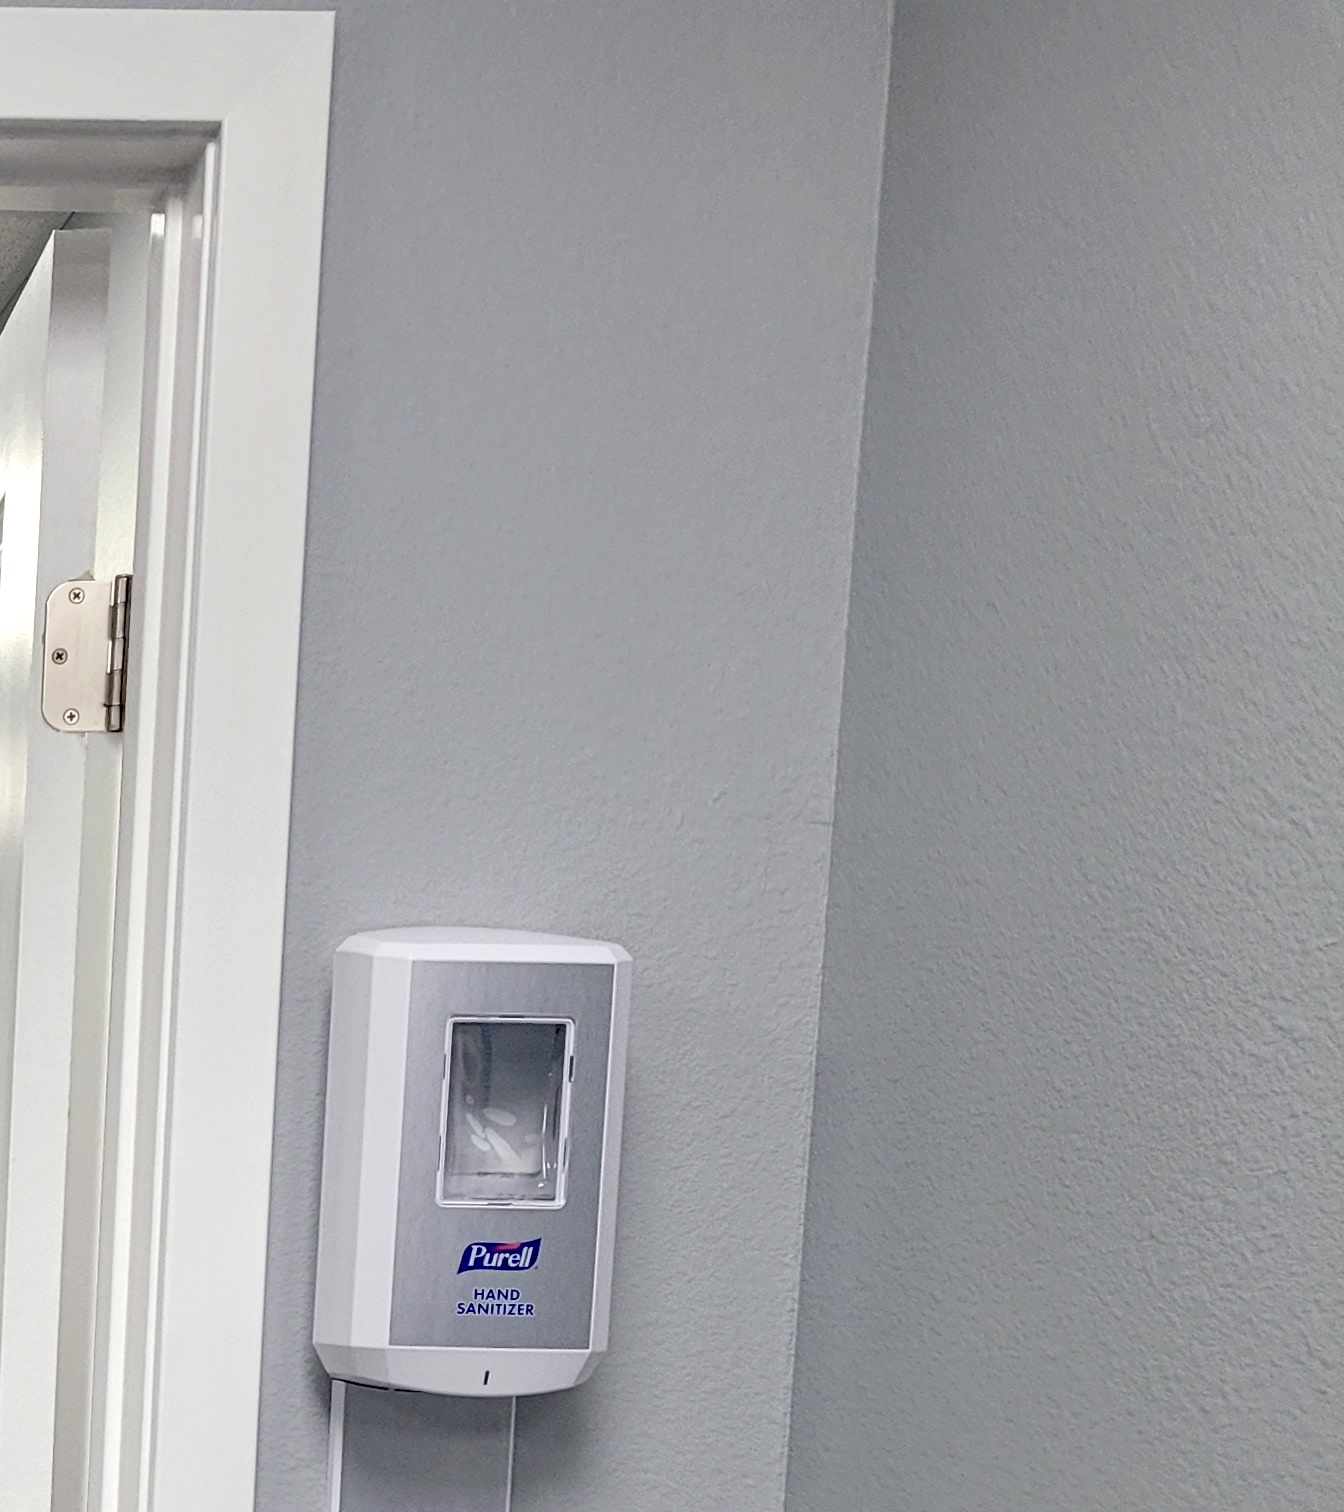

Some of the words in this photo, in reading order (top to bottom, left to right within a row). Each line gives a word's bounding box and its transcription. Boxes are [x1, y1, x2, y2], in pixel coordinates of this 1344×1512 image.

[468, 1245, 533, 1267] Purell
[474, 1288, 520, 1301] HAND
[457, 1303, 534, 1316] SANITIZER
